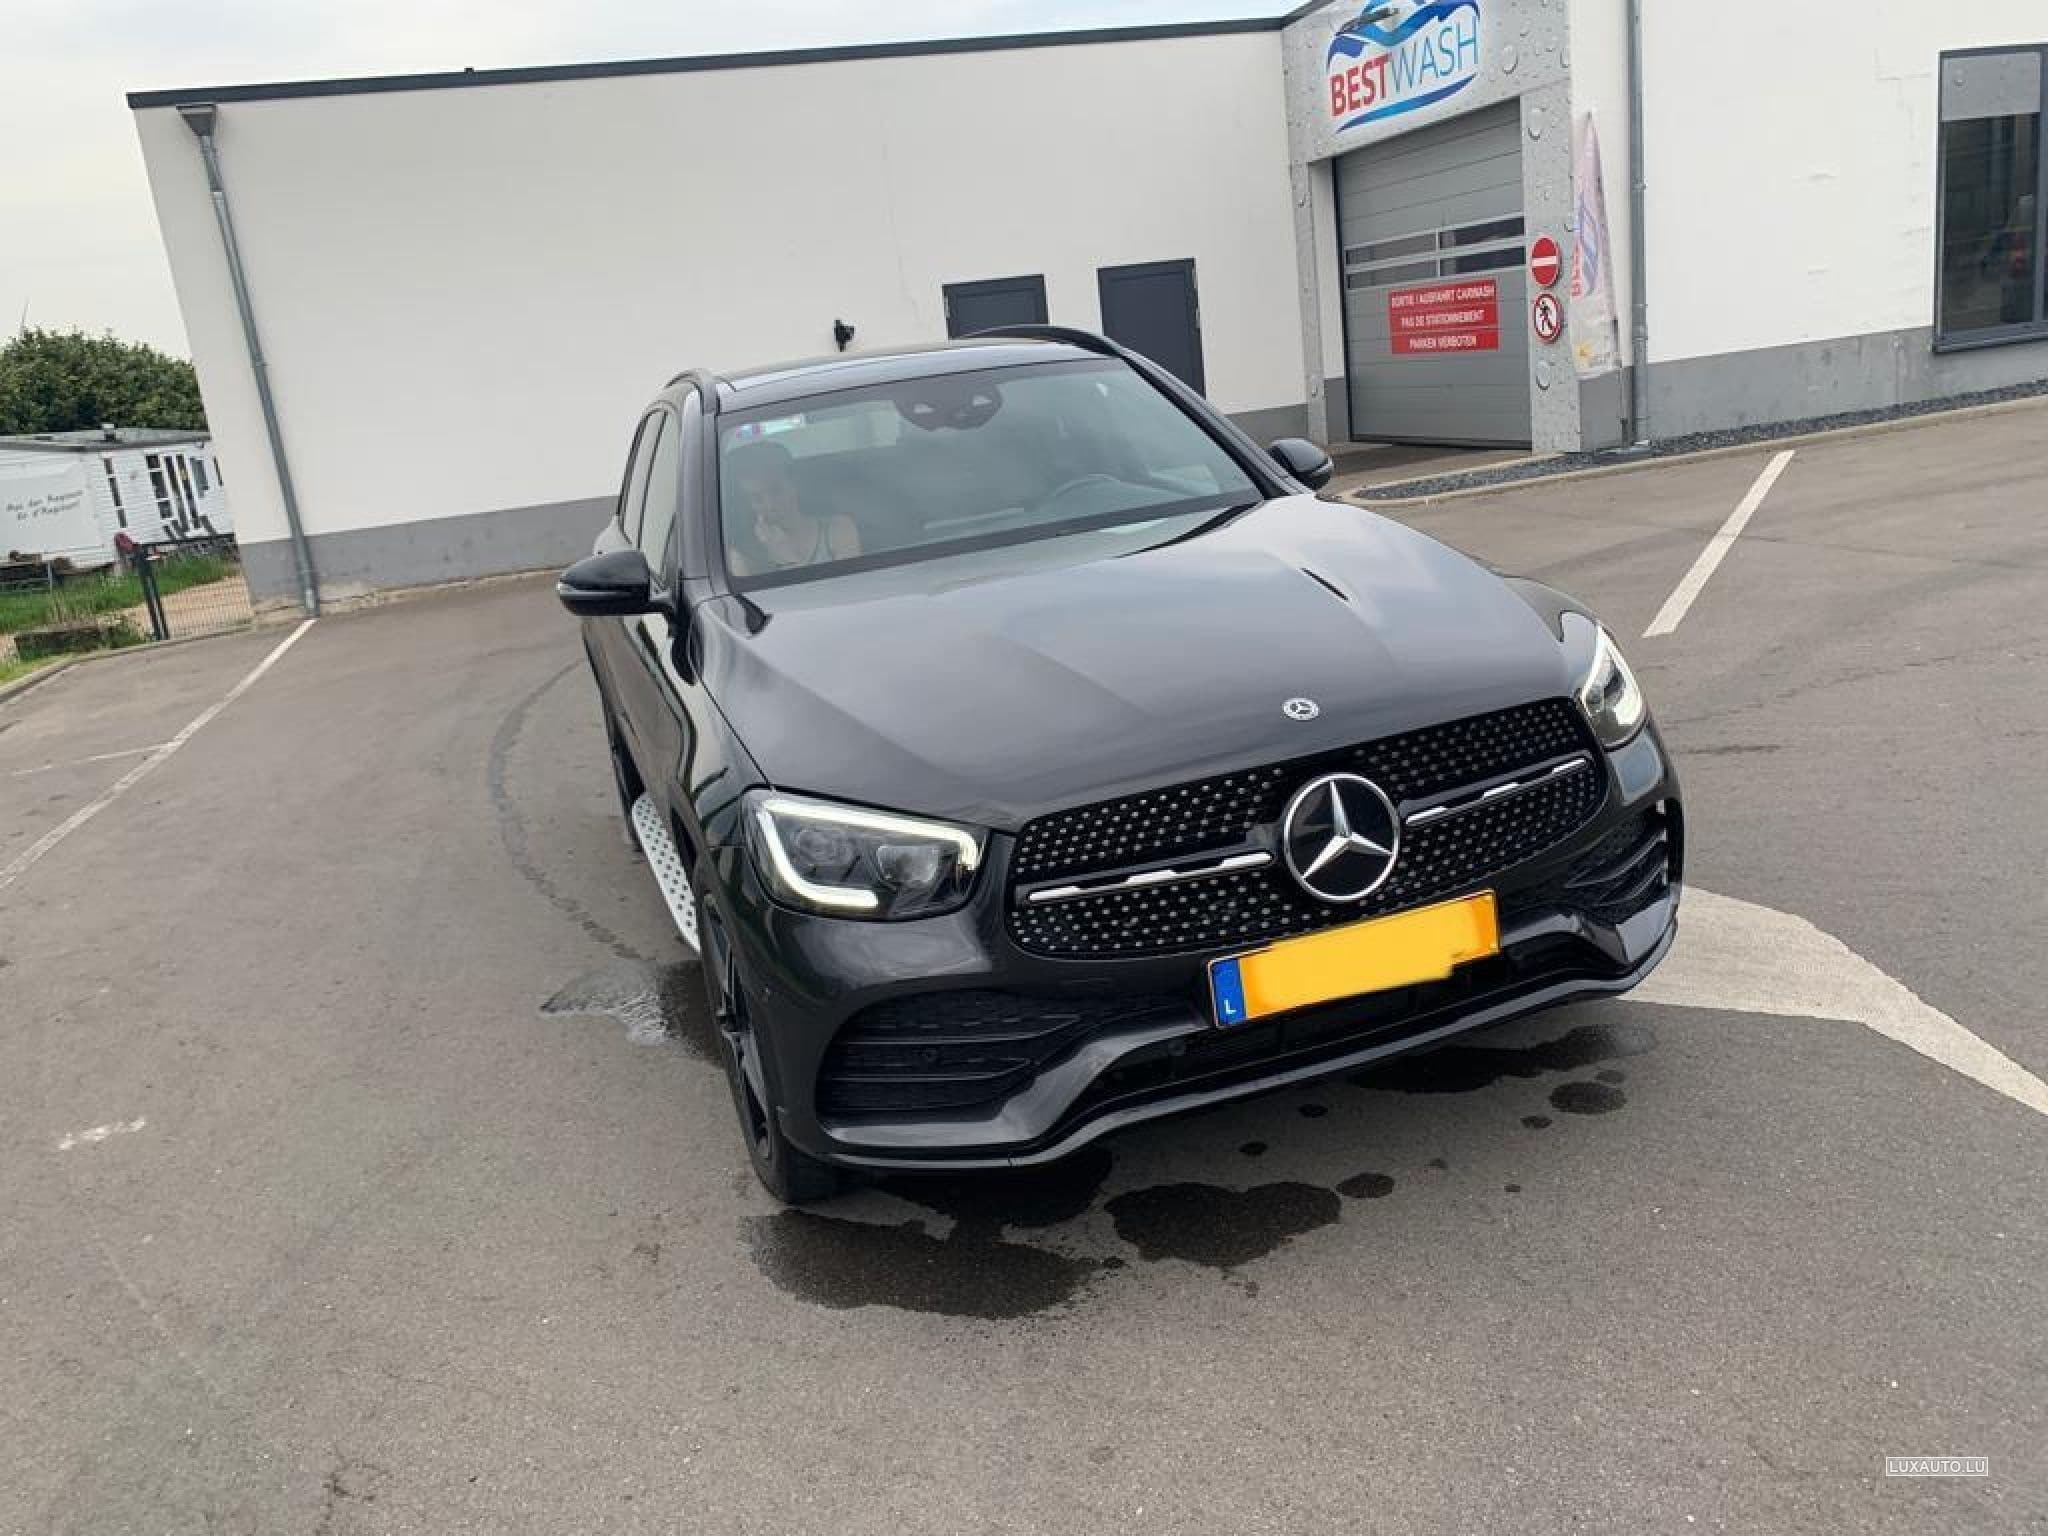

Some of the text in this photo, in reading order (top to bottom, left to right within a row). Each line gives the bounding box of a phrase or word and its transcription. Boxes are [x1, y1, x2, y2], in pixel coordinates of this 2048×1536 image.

[1456, 285, 1494, 300] CARWASH
[1409, 338, 1436, 350] PARKEN
[1224, 999, 1237, 1015] L
